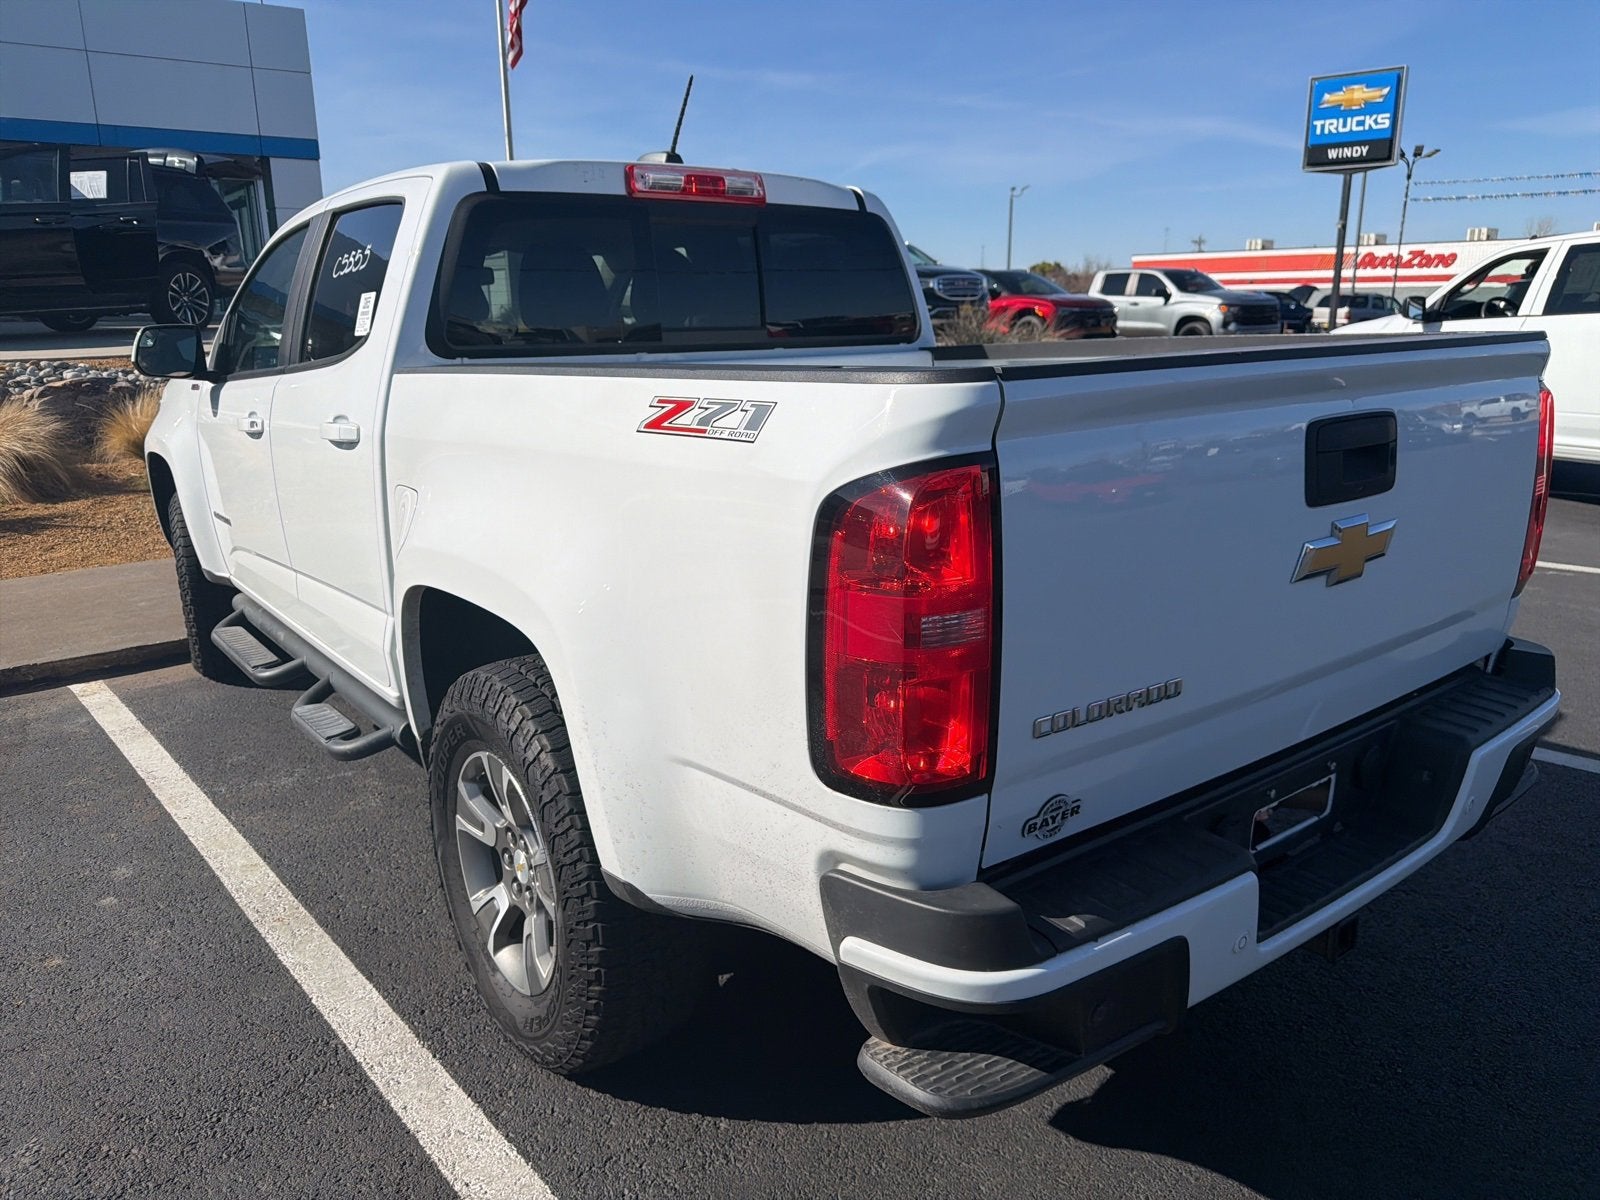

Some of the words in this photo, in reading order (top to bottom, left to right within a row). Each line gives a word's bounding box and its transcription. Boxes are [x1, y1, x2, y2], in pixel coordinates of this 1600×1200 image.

[1313, 113, 1391, 136] TRUCKS
[1327, 145, 1369, 159] WINDY
[1357, 250, 1457, 269] AutoZone
[637, 396, 777, 438] Z71
[728, 430, 755, 439] ROAD
[1033, 677, 1183, 739] COLORADO
[1027, 804, 1081, 835] BAYER
